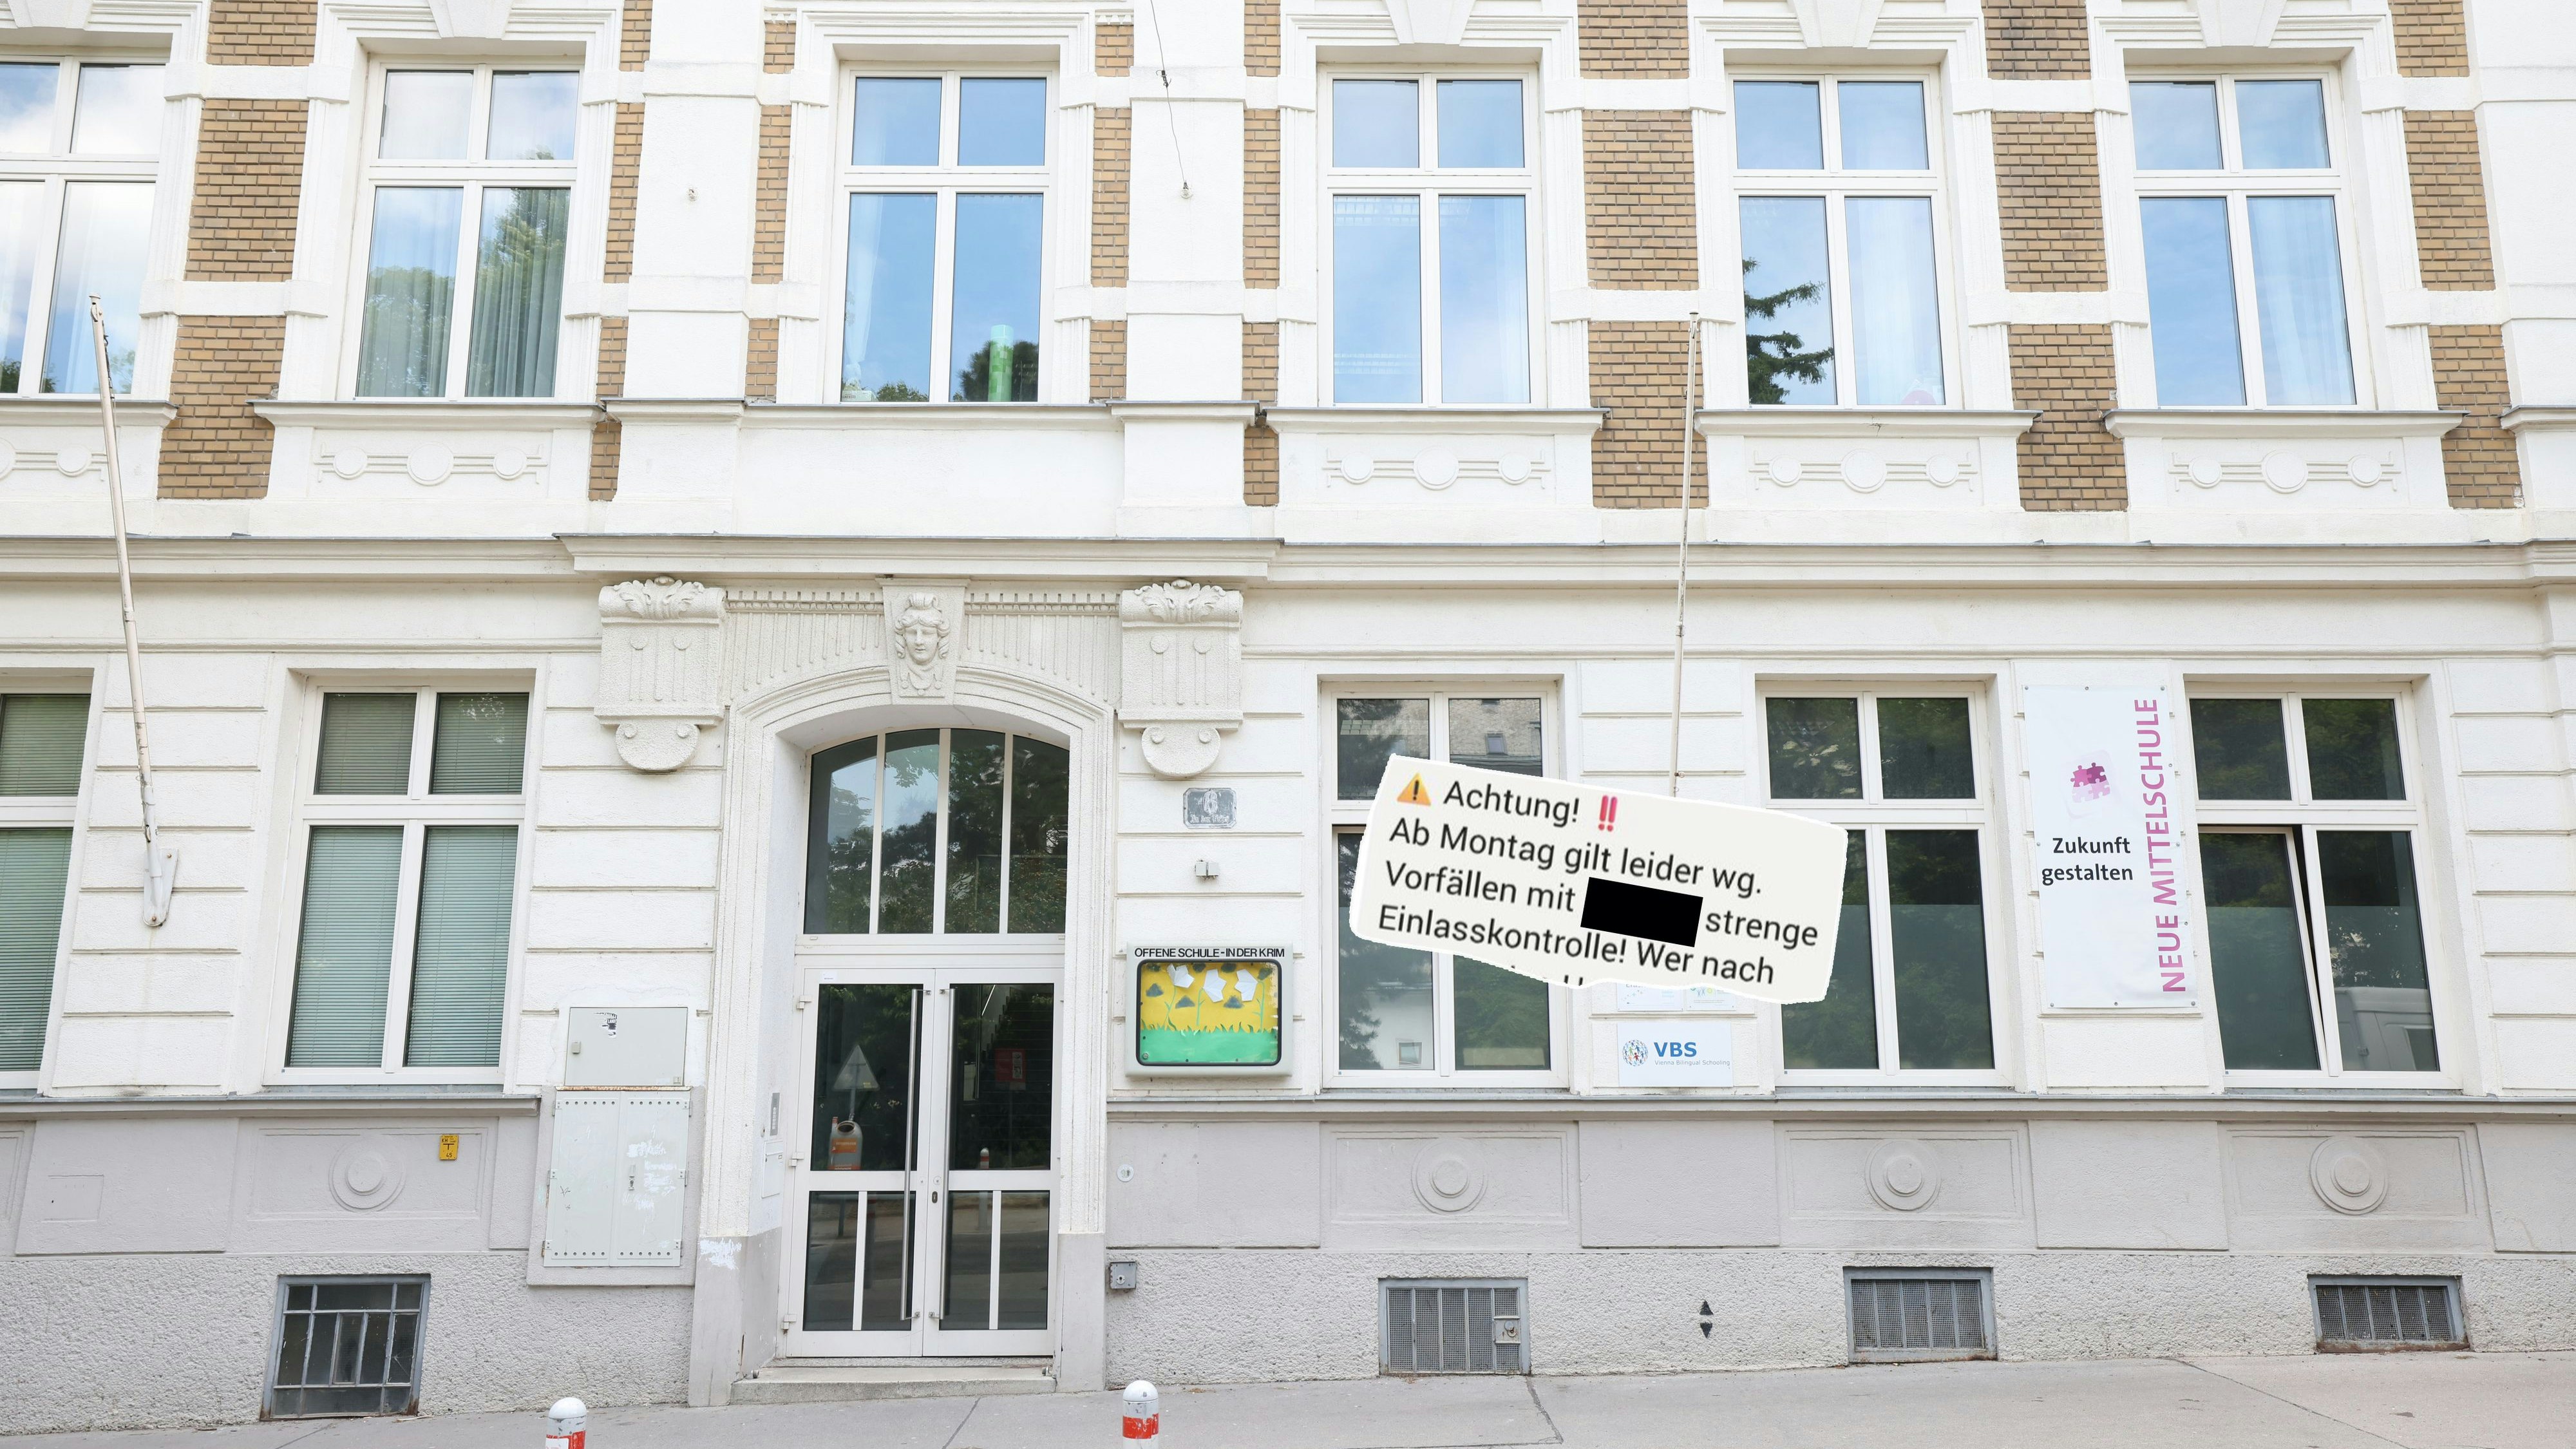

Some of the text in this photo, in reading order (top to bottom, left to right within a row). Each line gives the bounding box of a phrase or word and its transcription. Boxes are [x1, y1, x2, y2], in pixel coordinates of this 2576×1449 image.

[2052, 837, 2131, 855] Zukunft
[2134, 699, 2186, 992] NEUE MITTELSCHULE
[2041, 864, 2134, 886] gestalten
[1134, 947, 1176, 958] OFFENE
[1178, 948, 1220, 958] SCHULE
[1236, 948, 1257, 958] DER
[1259, 948, 1285, 958] KRIM
[1653, 1041, 1697, 1057] VBS
